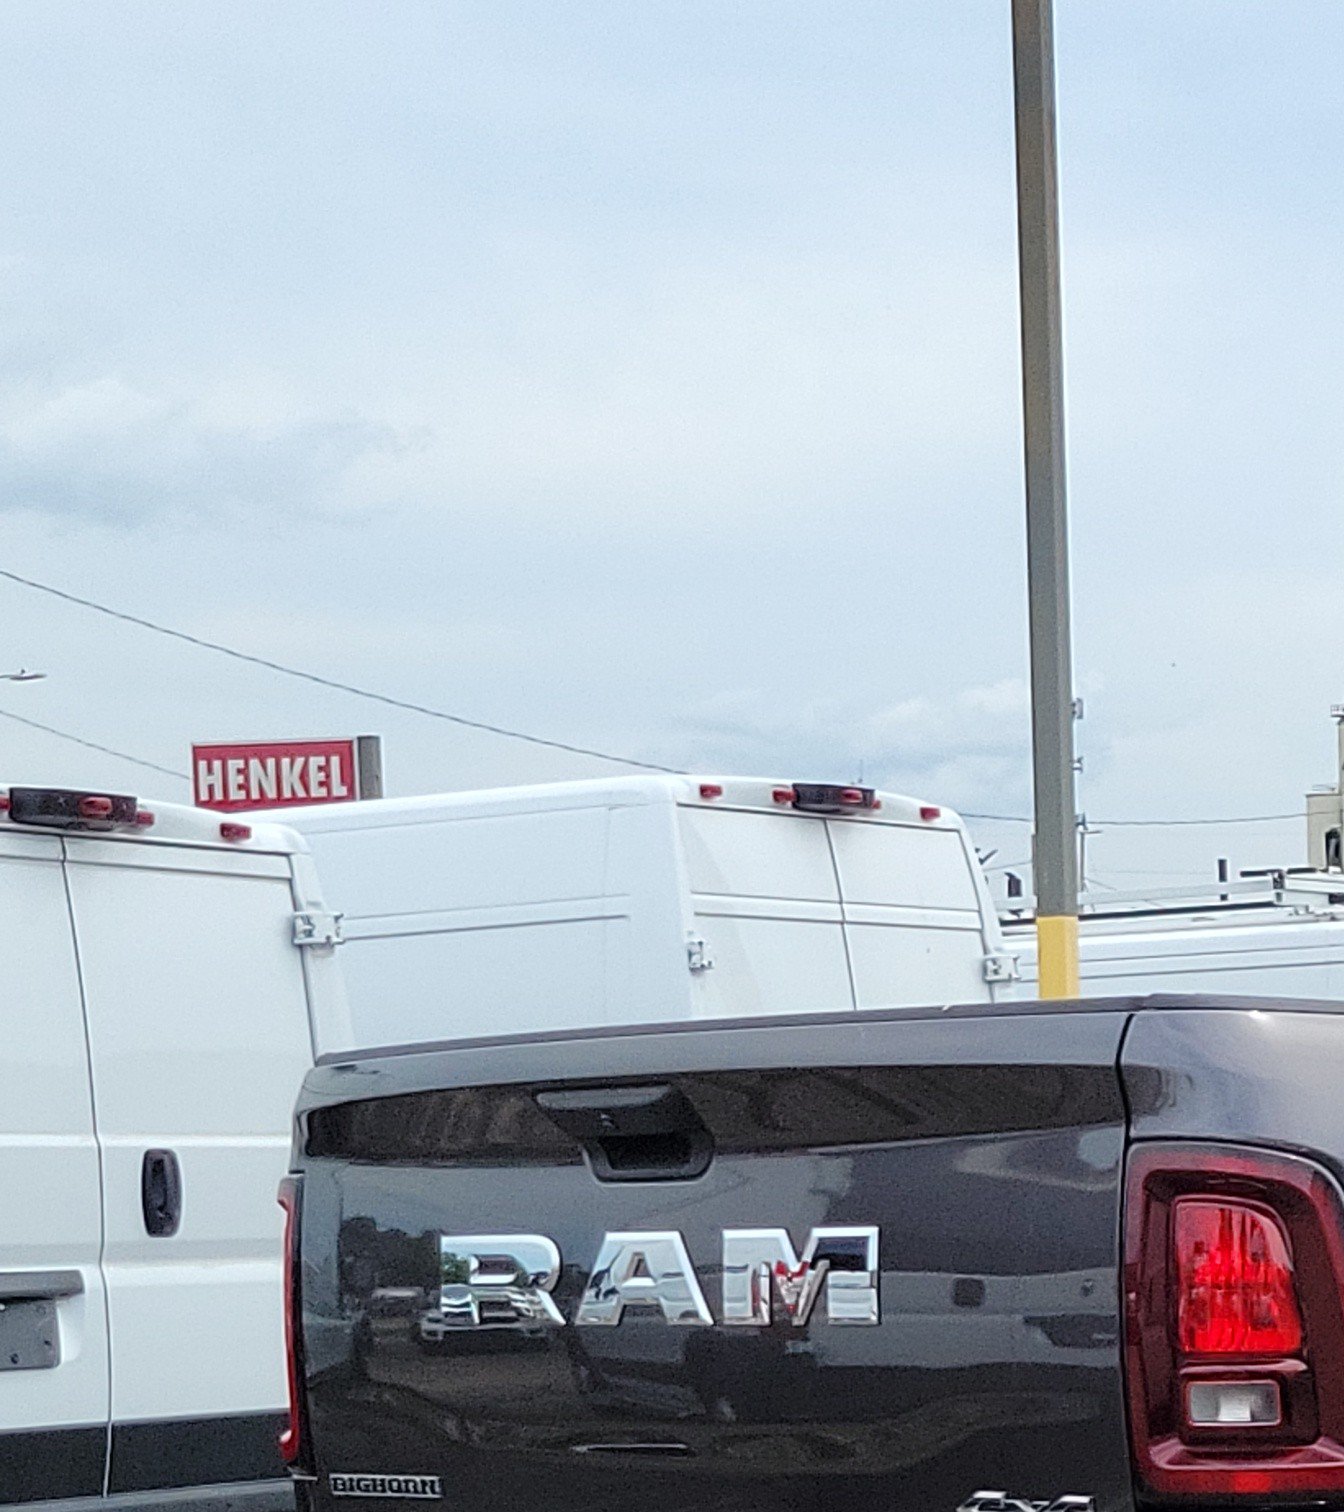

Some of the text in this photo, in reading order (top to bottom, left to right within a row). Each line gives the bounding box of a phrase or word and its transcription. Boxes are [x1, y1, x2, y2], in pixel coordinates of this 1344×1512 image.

[198, 755, 347, 801] HENKEL
[440, 1226, 880, 1327] RAM
[331, 1476, 439, 1496] BIGHORN
